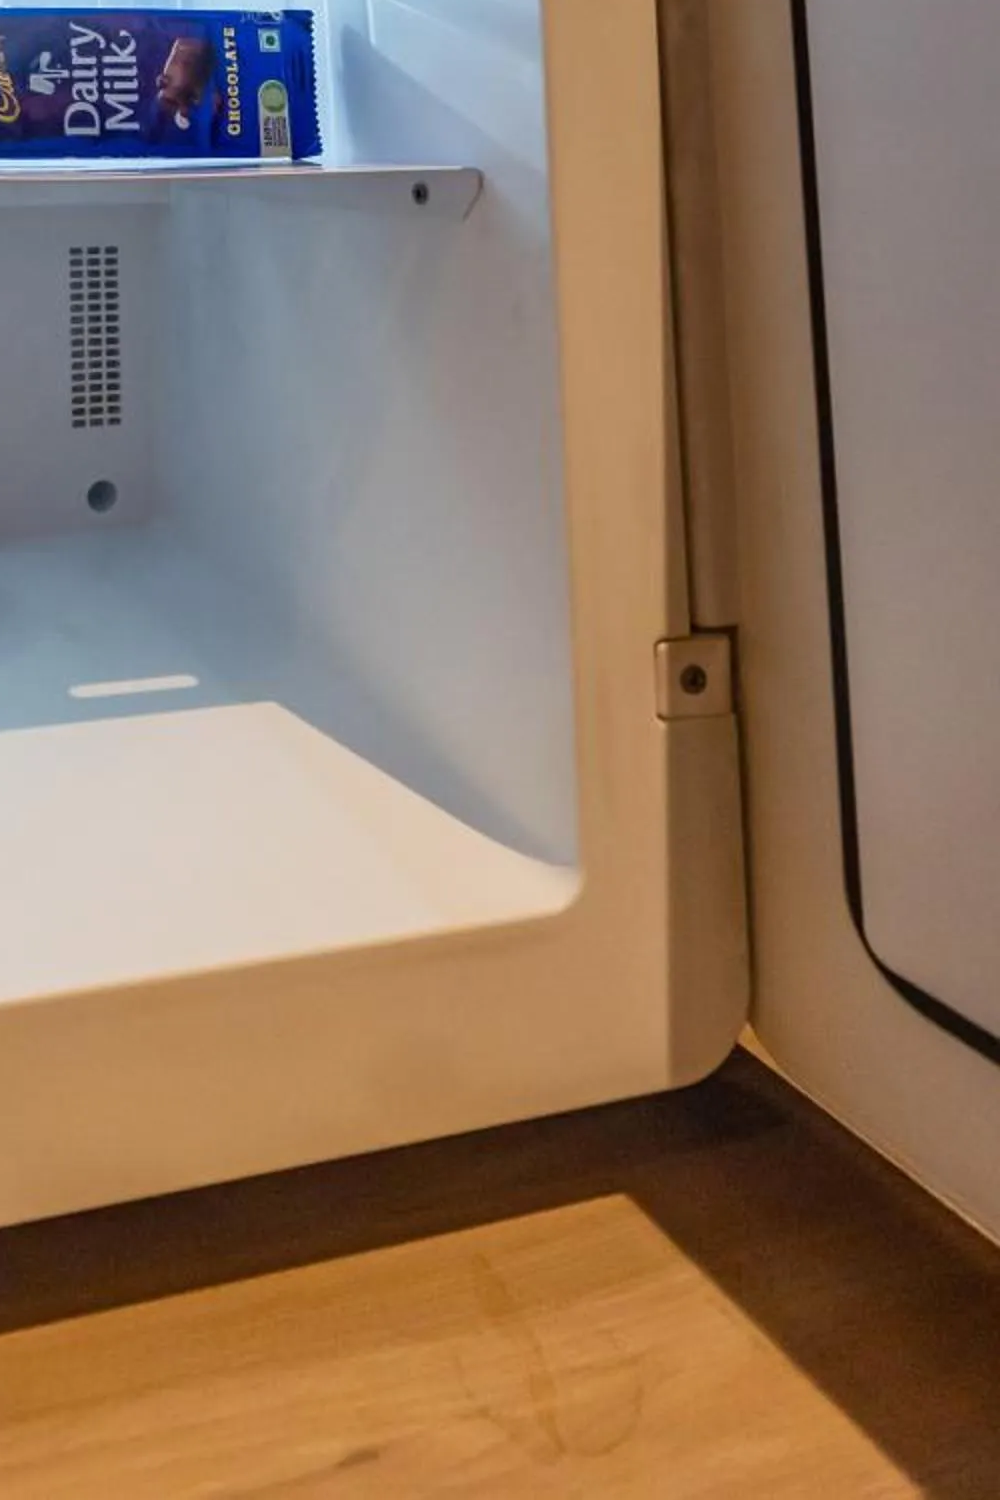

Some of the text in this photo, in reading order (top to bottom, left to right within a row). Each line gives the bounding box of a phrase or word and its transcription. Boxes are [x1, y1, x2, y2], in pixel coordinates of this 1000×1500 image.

[64, 21, 106, 138] Dairy
[103, 29, 140, 132] Milk
[222, 27, 242, 136] CHOCOLATE
